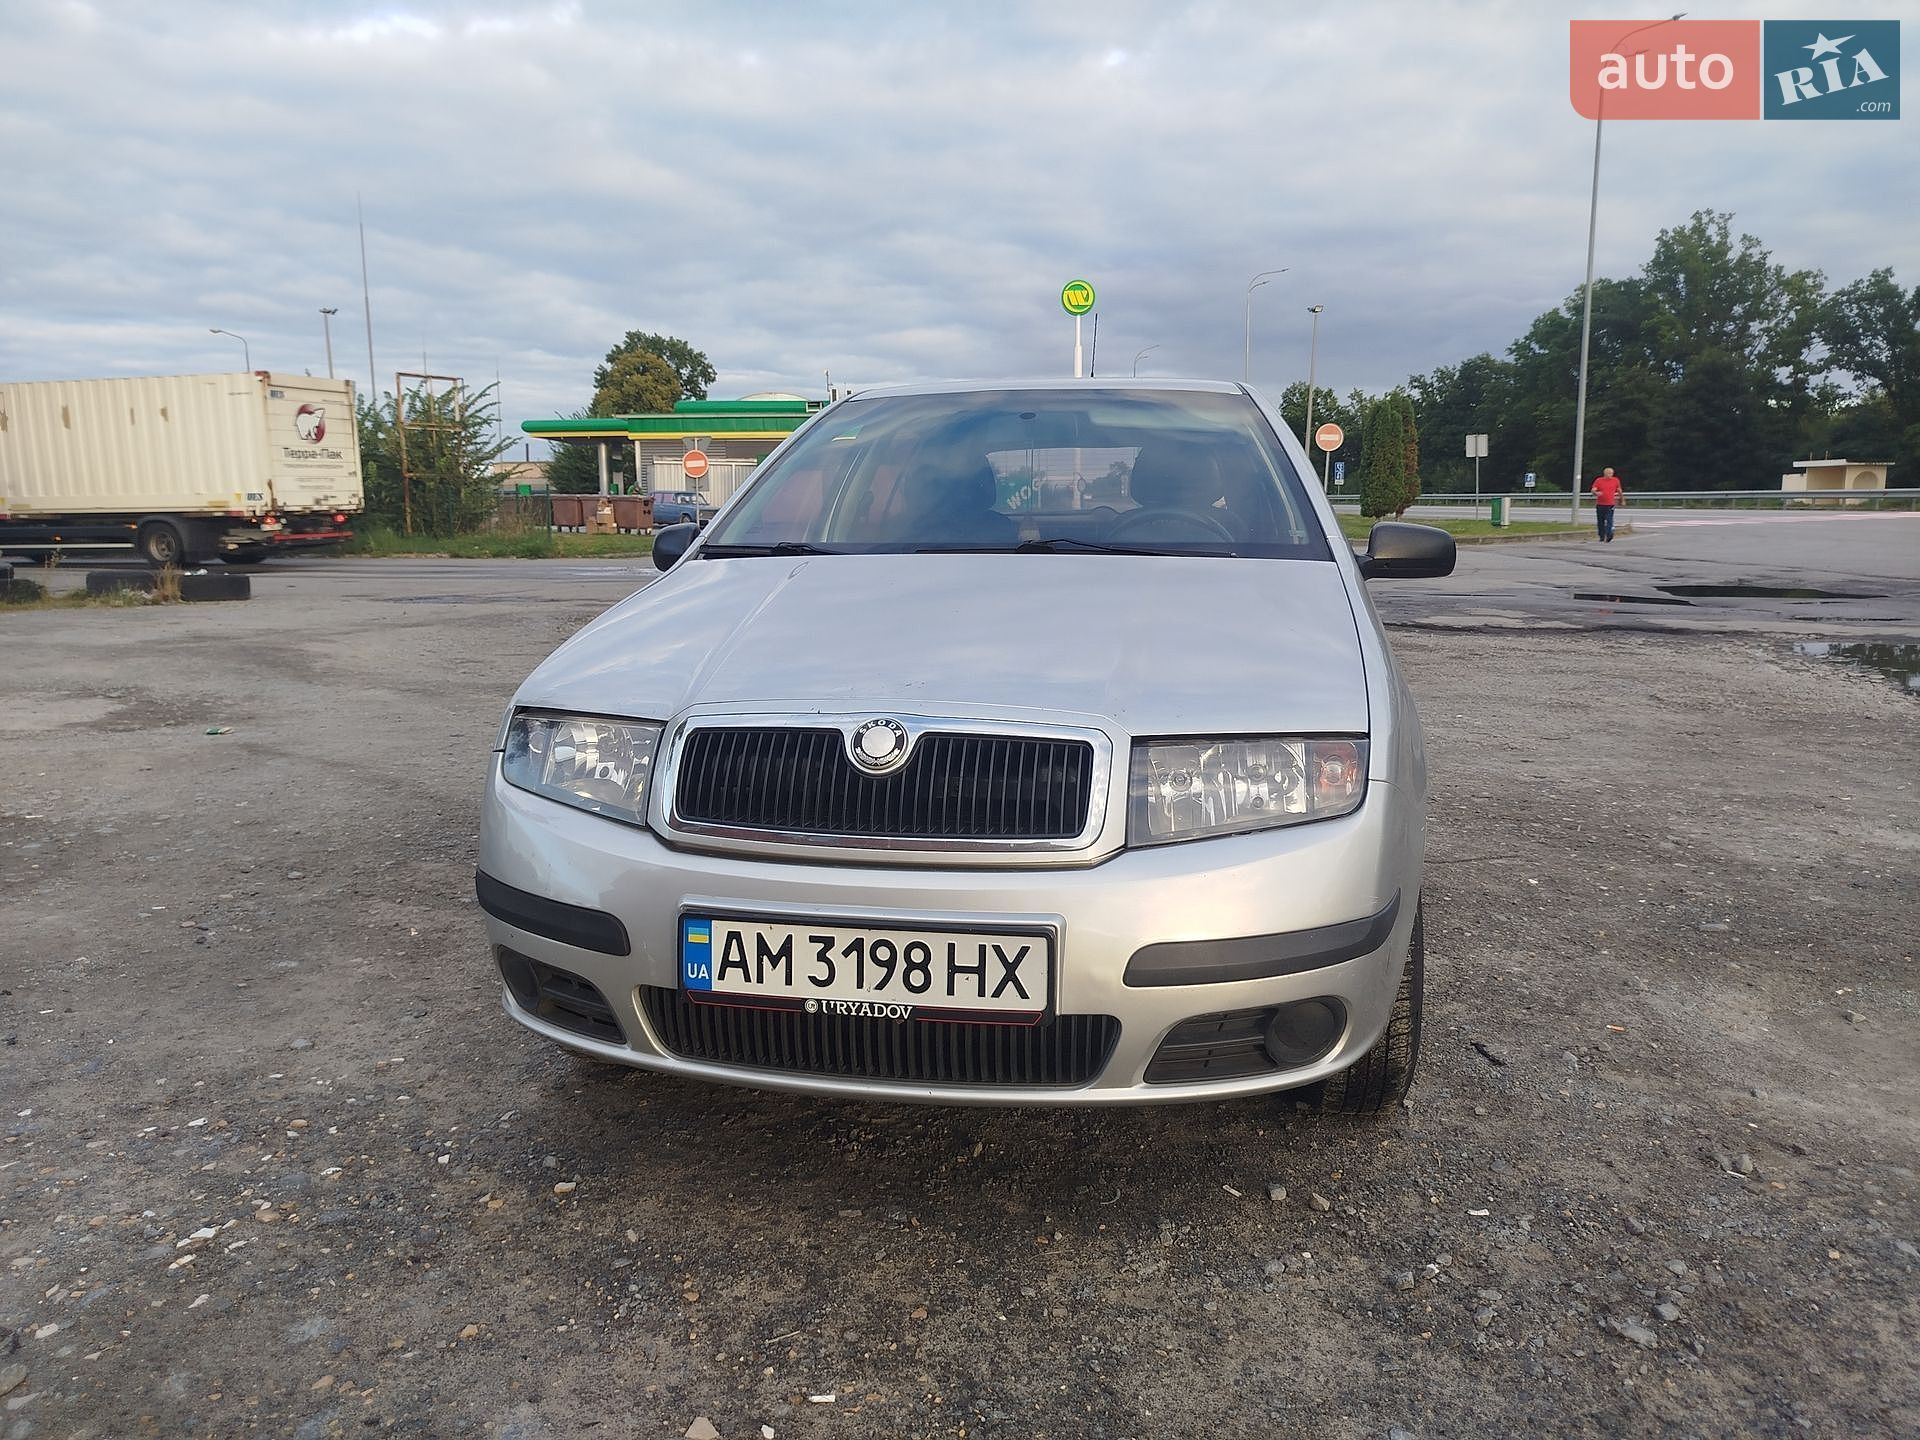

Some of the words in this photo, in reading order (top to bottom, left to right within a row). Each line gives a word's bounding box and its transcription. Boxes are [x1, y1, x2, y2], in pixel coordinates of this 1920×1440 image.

[688, 963, 710, 980] UA
[717, 930, 793, 987] AM
[807, 935, 933, 995] 3198
[946, 941, 1032, 1000] HX
